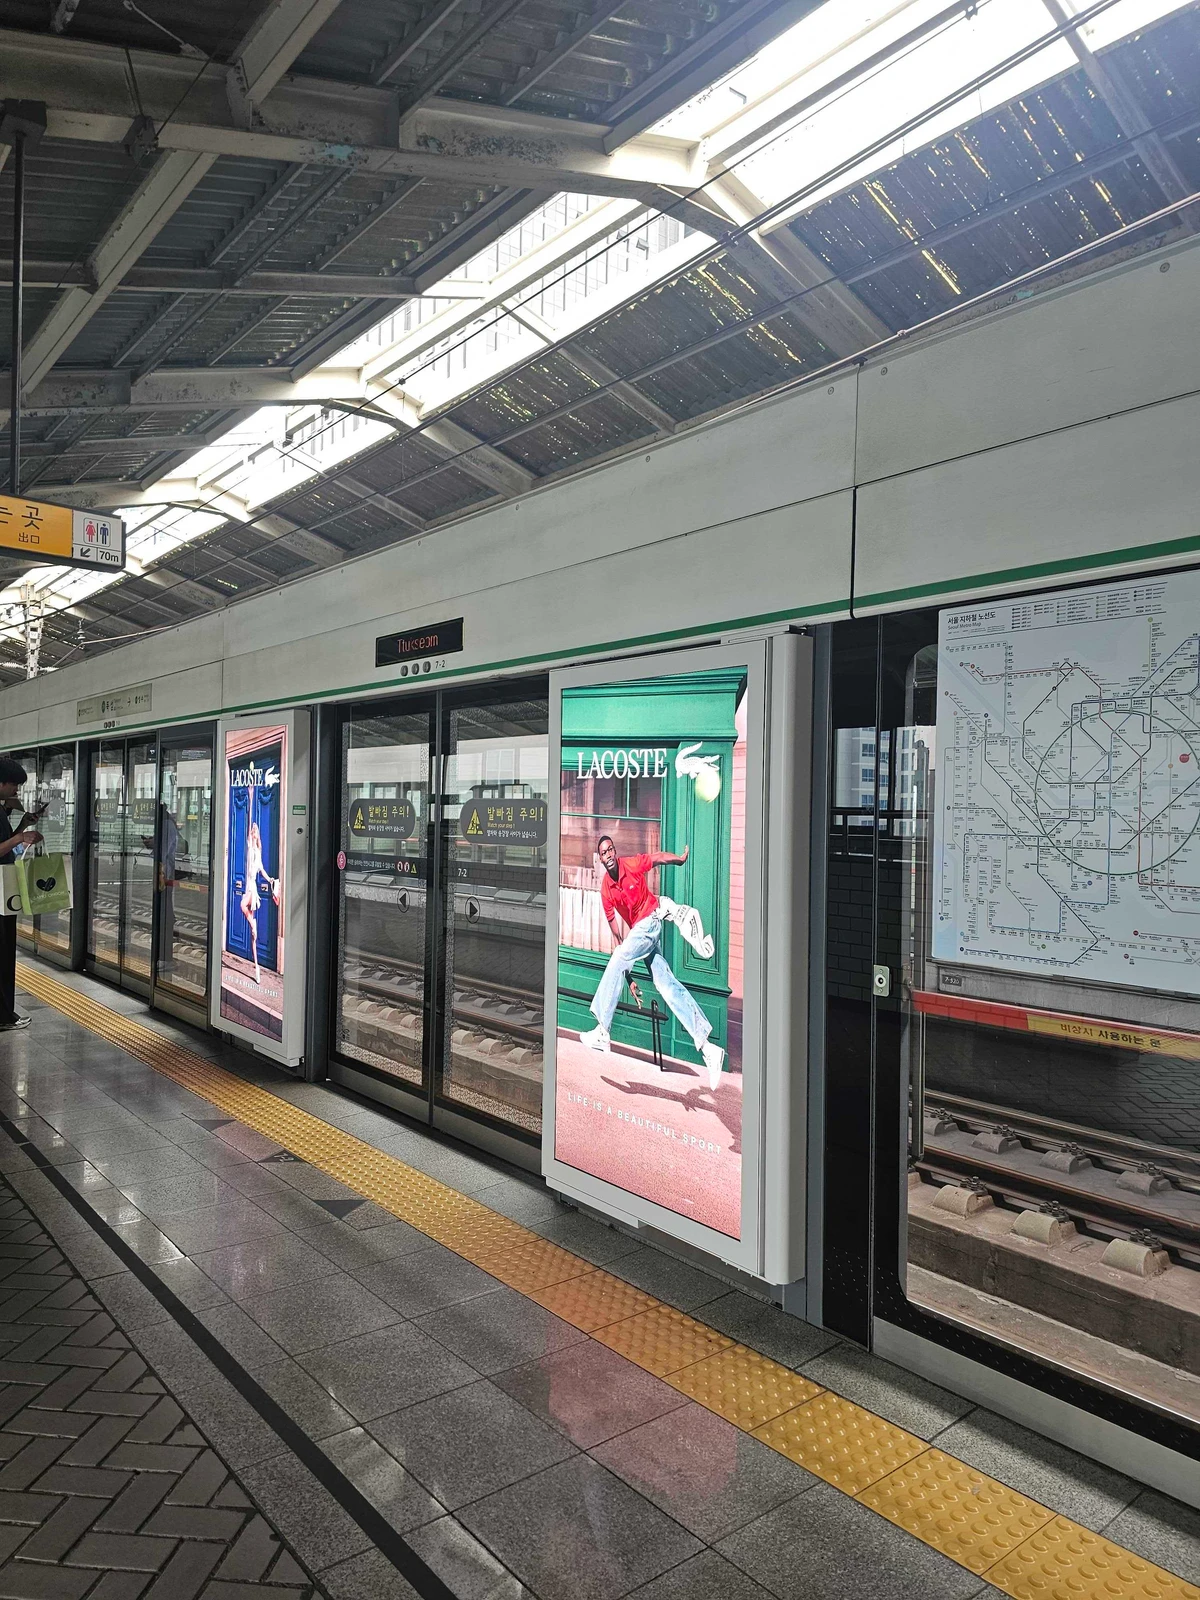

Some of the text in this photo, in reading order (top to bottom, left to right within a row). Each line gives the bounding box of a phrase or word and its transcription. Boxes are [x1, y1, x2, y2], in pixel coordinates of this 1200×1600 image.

[21, 505, 44, 530] 곳
[18, 531, 40, 544] 出口
[99, 550, 119, 562] 70m
[960, 614, 977, 623] 지하철
[979, 612, 996, 620] 노선도
[435, 660, 446, 669] 7-2
[577, 748, 668, 780] LACOSTE
[230, 768, 264, 787] LACOSTE
[368, 805, 409, 818] 발빠짐 주의!
[487, 806, 544, 821] 발빠짐 주의!
[1060, 1023, 1093, 1037] 비상시
[1098, 1030, 1145, 1045] 사용하는
[568, 1092, 722, 1155] LIFE IS A BEAUTIFUL SPORT
